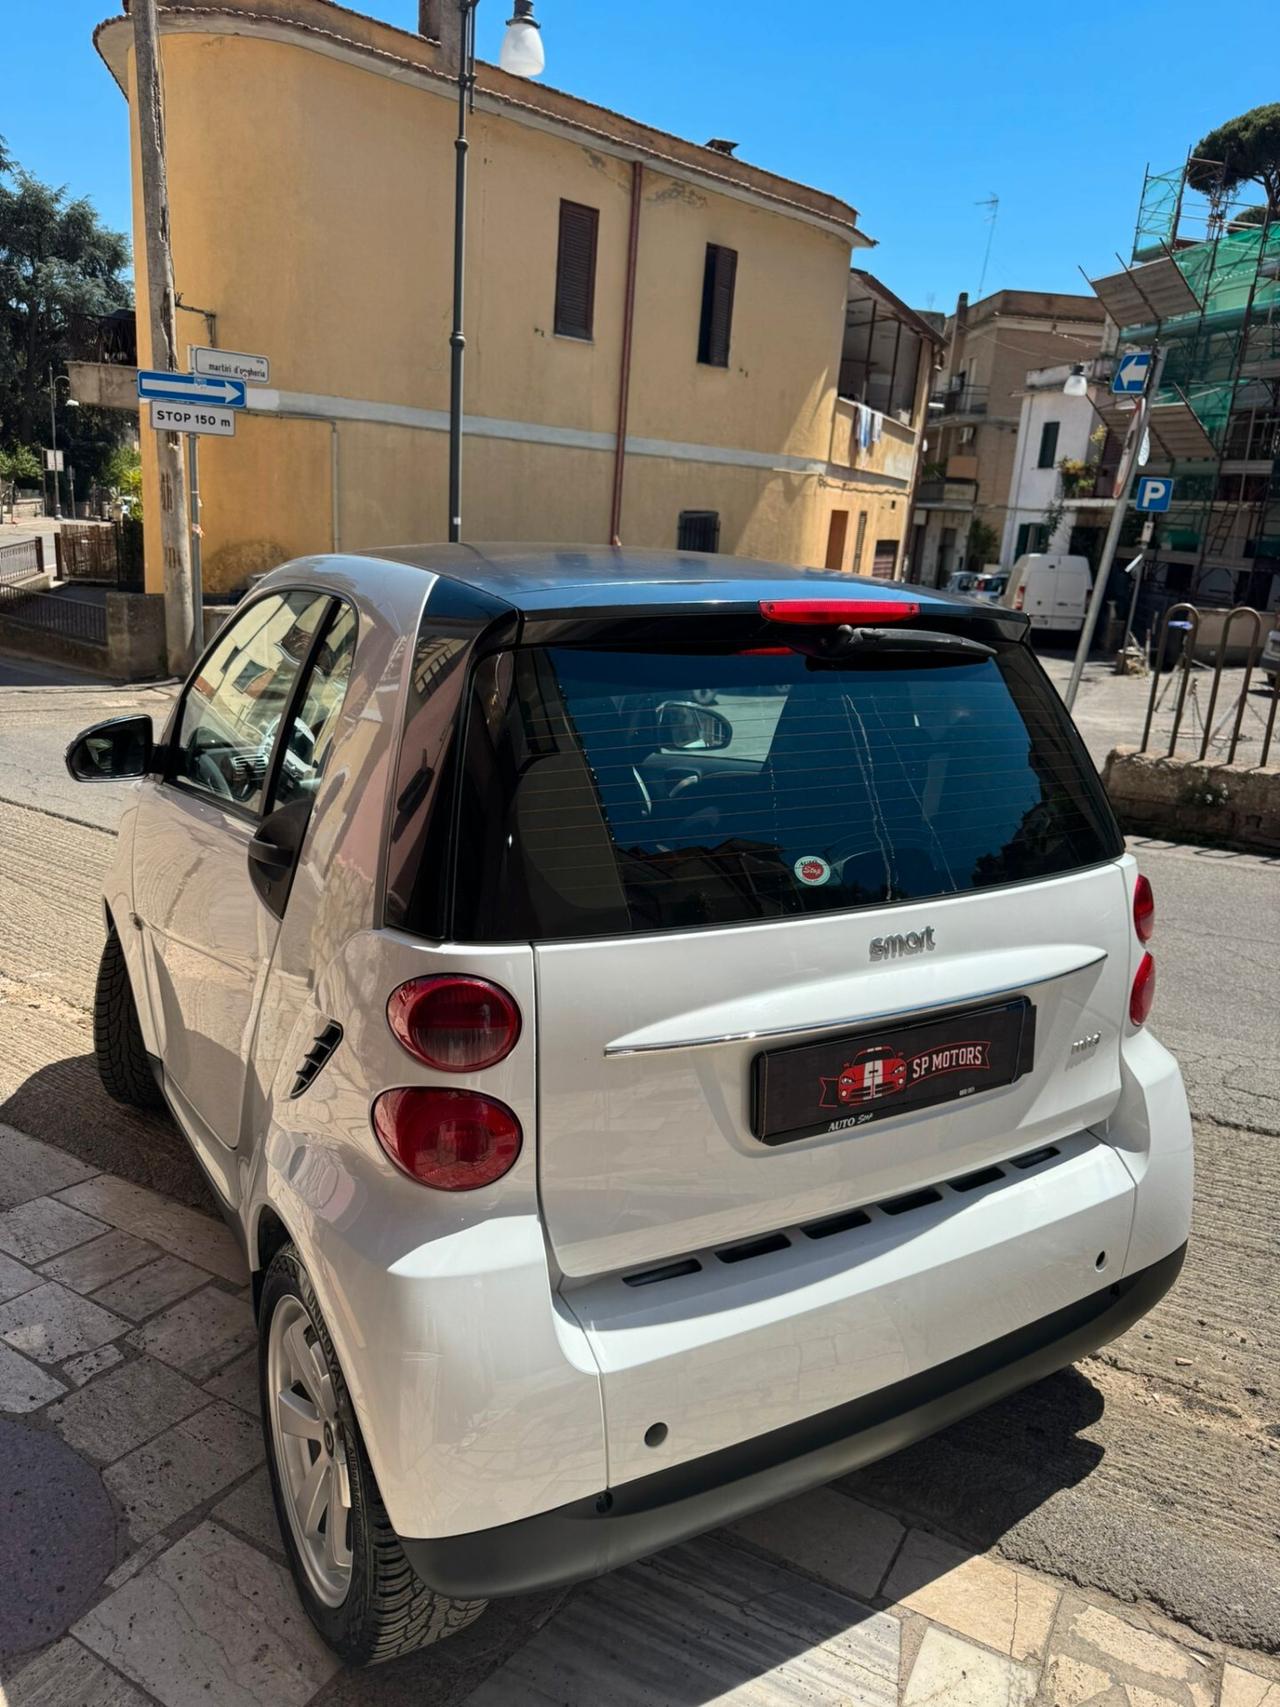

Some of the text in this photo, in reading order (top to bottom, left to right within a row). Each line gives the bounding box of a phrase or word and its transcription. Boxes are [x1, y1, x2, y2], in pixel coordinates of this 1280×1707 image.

[157, 410, 231, 427] STOP 150 m
[1142, 481, 1166, 508] P
[869, 926, 936, 961] smart
[912, 1046, 982, 1078] SP MOTORS
[828, 1117, 855, 1132] AUTO
